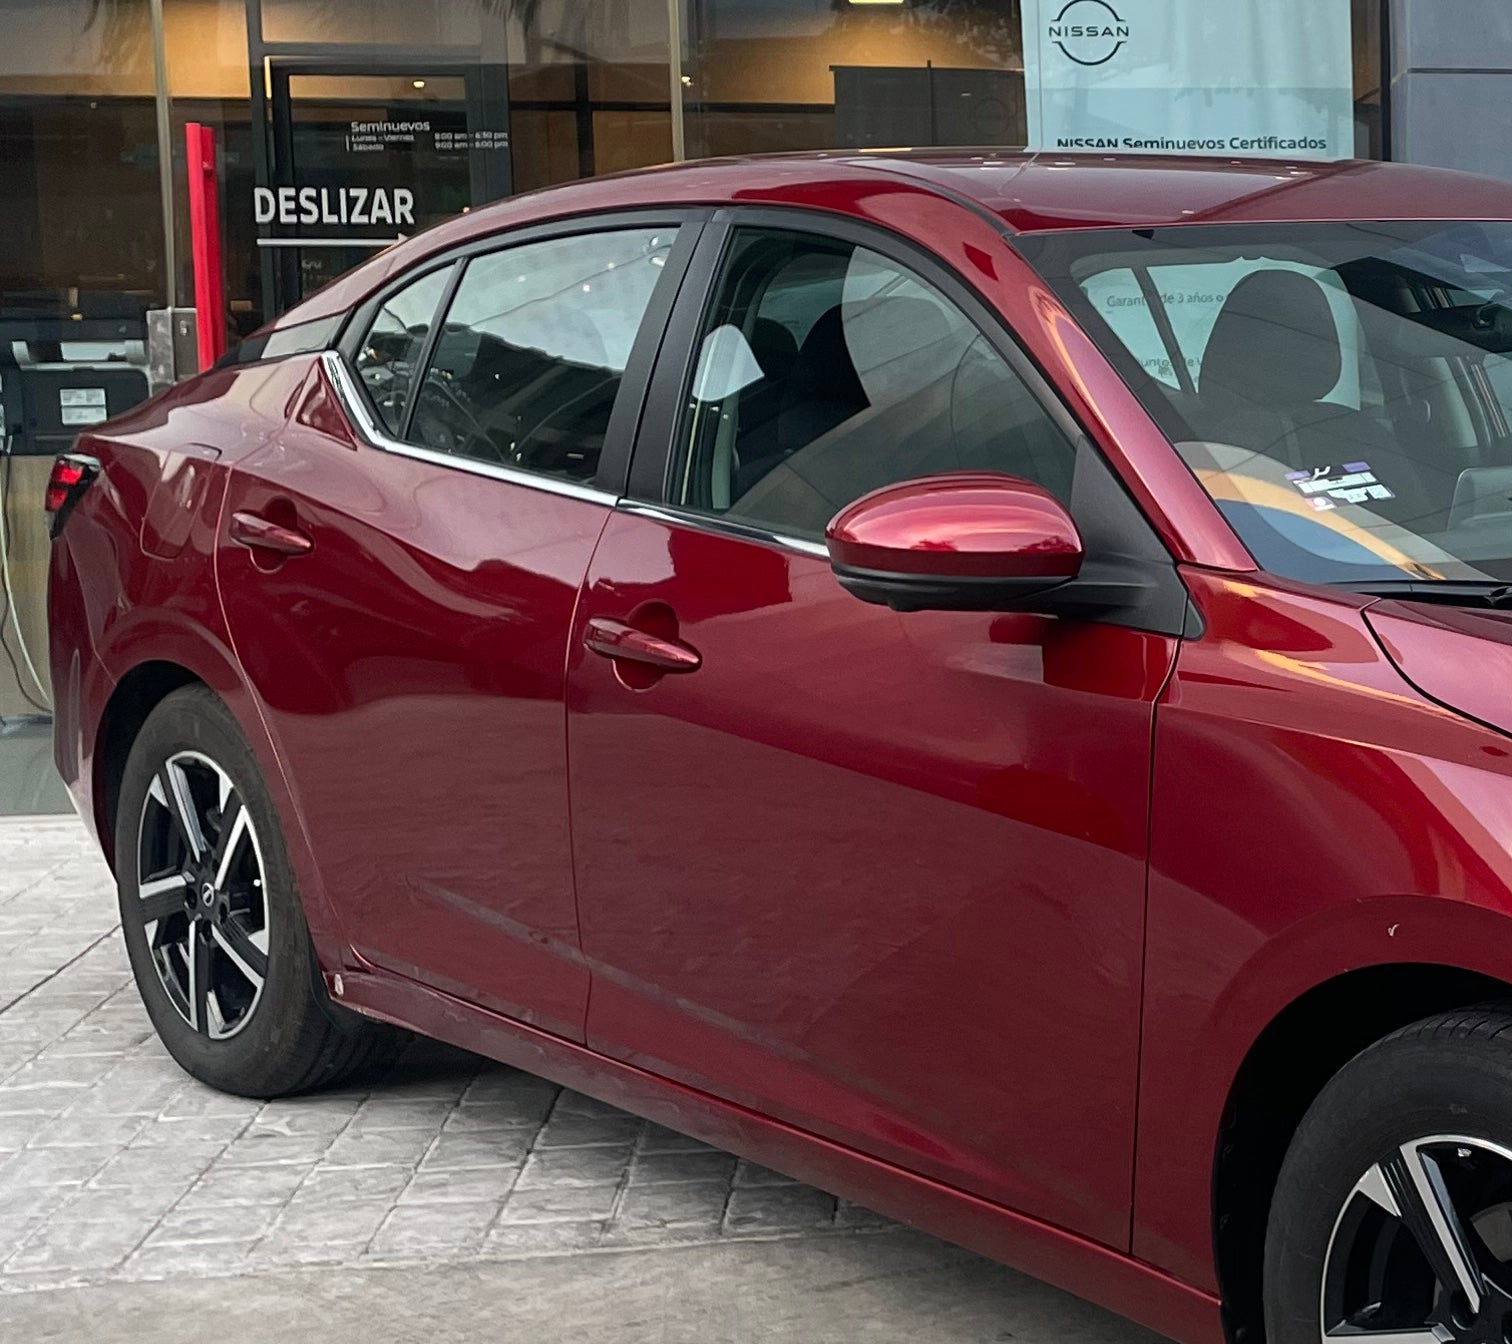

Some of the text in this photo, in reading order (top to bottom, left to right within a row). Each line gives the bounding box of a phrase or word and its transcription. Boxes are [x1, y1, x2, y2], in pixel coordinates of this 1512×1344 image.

[1048, 26, 1129, 37] NISSAN
[351, 121, 430, 133] Seminuevos
[1057, 136, 1327, 150] NISSAN Seminuevos Certificados
[253, 186, 415, 225] DESLIZAR
[1106, 295, 1147, 307] Garant
